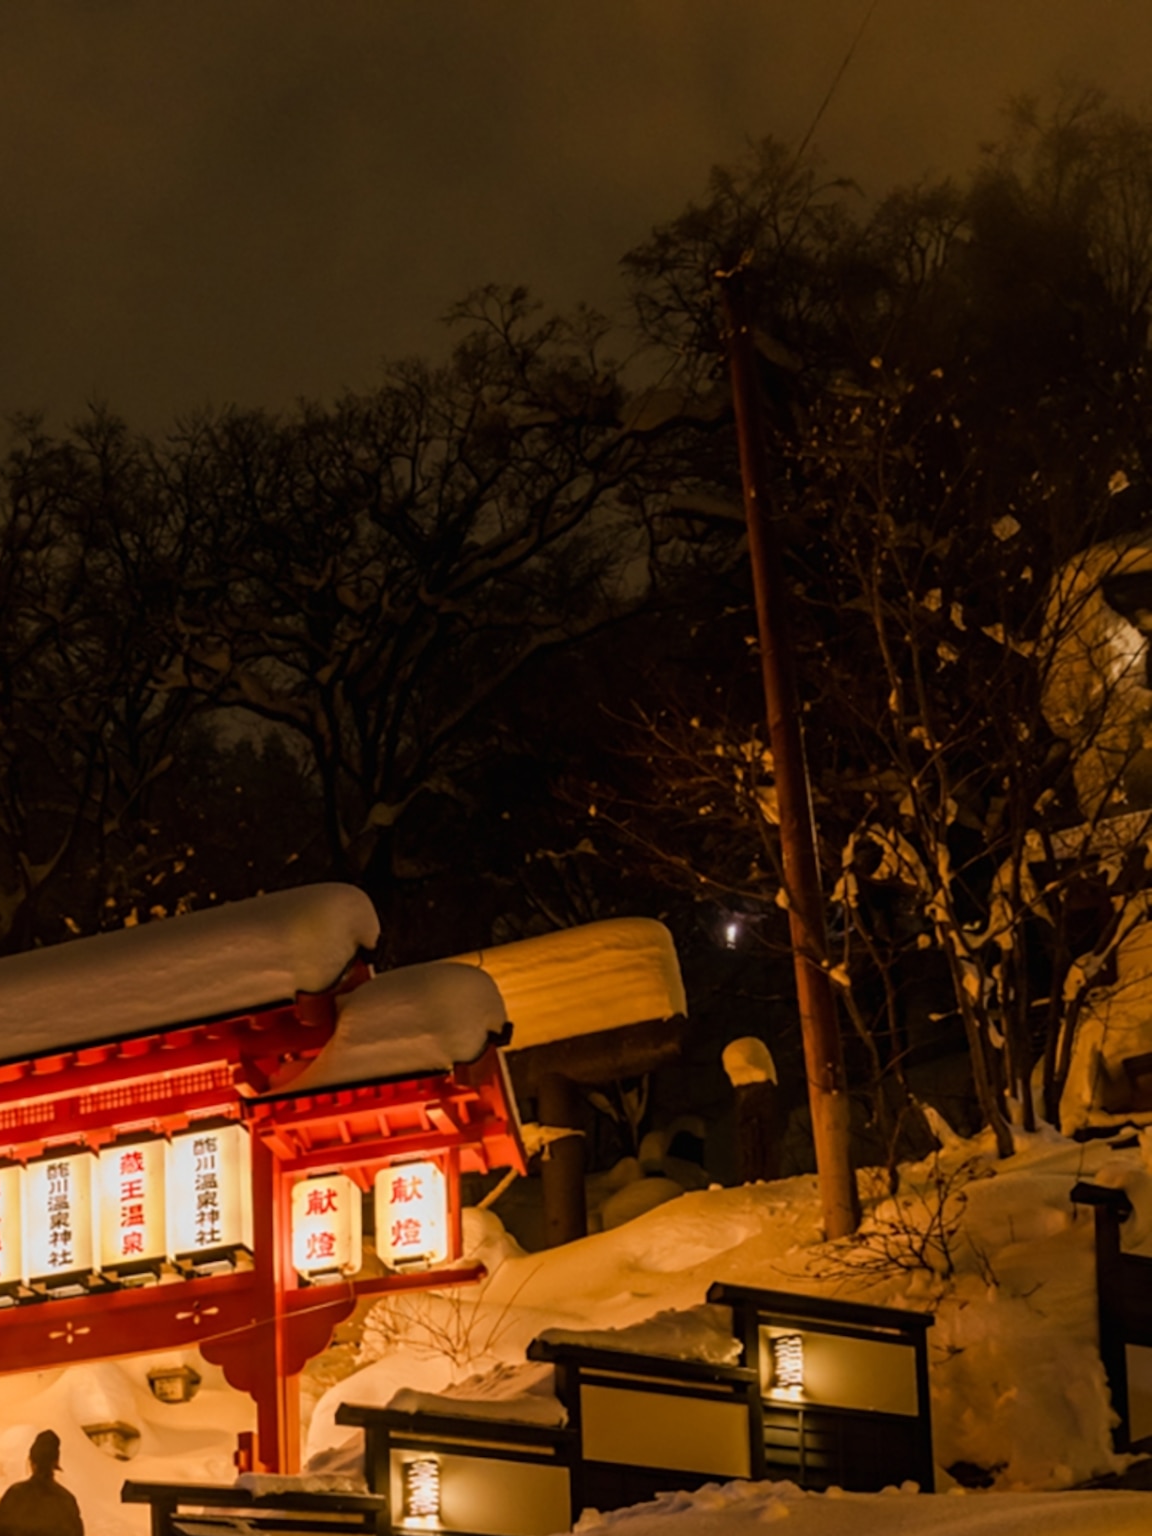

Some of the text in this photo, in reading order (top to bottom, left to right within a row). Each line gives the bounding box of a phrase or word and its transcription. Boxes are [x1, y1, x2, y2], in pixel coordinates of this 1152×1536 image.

[119, 1150, 145, 1255] 蔵王温泉
[305, 1188, 338, 1260] 献燈
[389, 1175, 423, 1247] 献燈
